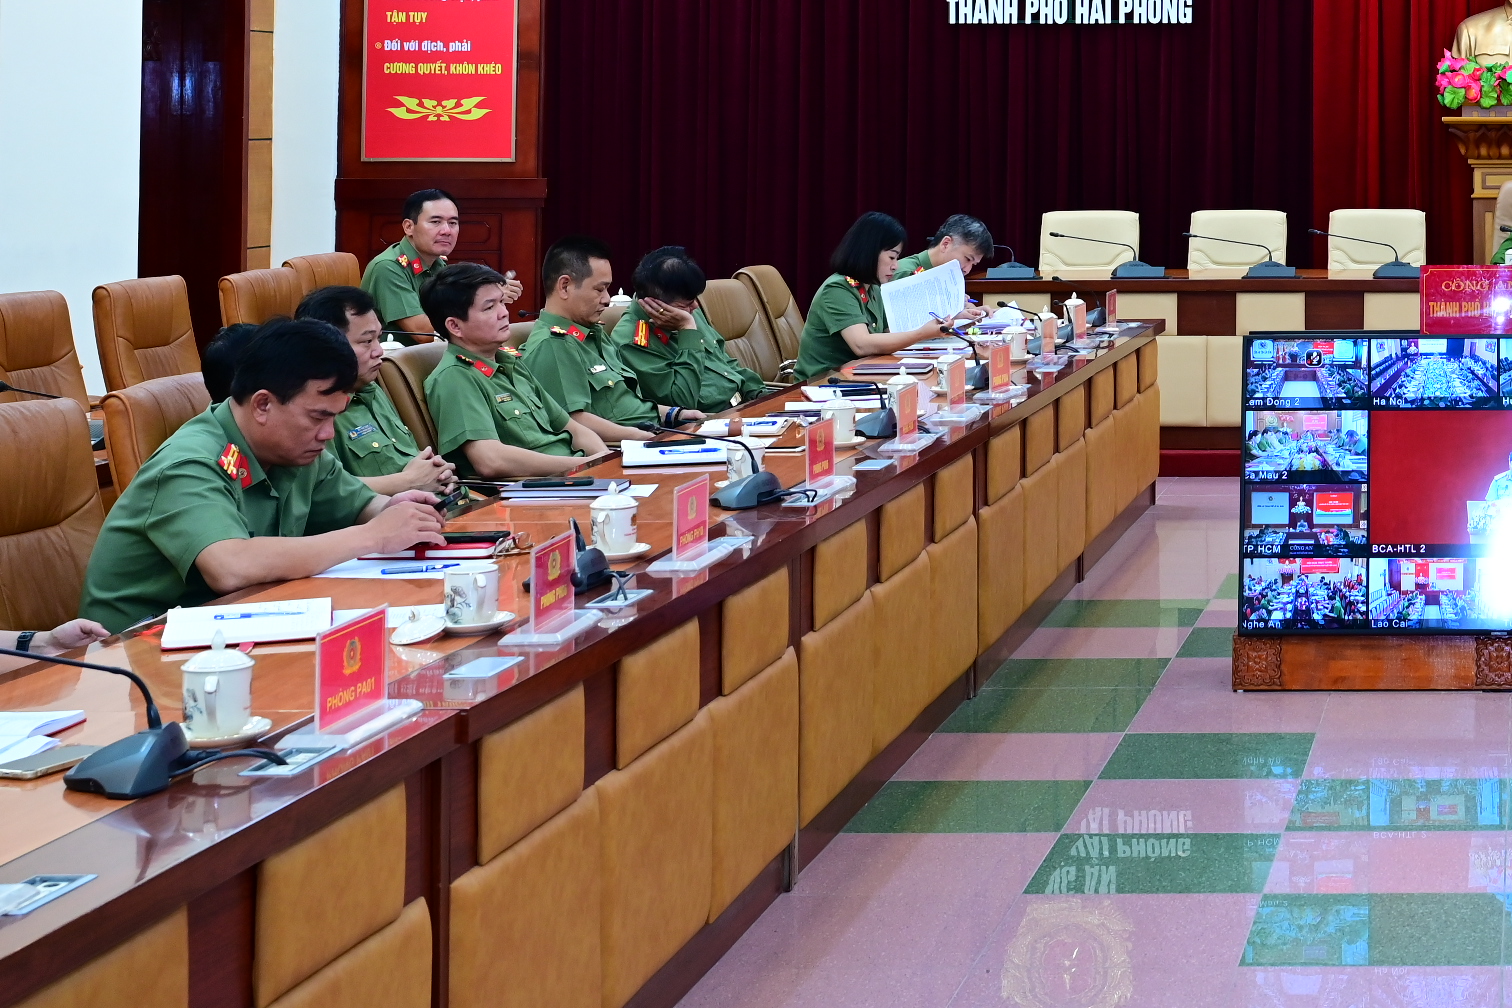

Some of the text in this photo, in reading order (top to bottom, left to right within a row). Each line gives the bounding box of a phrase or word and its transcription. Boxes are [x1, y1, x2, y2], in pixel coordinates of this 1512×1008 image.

[386, 10, 427, 24] TẬN TỤY
[384, 60, 501, 75] CƯƠNG QUYẾT, KHÔN KHÉO
[1441, 278, 1490, 292] CÔNG
[1428, 299, 1460, 317] THÀNH
[1245, 397, 1300, 408] am Dong 2
[1373, 397, 1405, 406] Ha Noi
[1259, 471, 1279, 480] Mau
[1281, 471, 1288, 480] 2
[1371, 544, 1426, 553] BCA-HTL 2
[1268, 619, 1281, 628] An
[1371, 619, 1408, 628] Lao Cai
[326, 677, 376, 712] PHÒNG PA01
